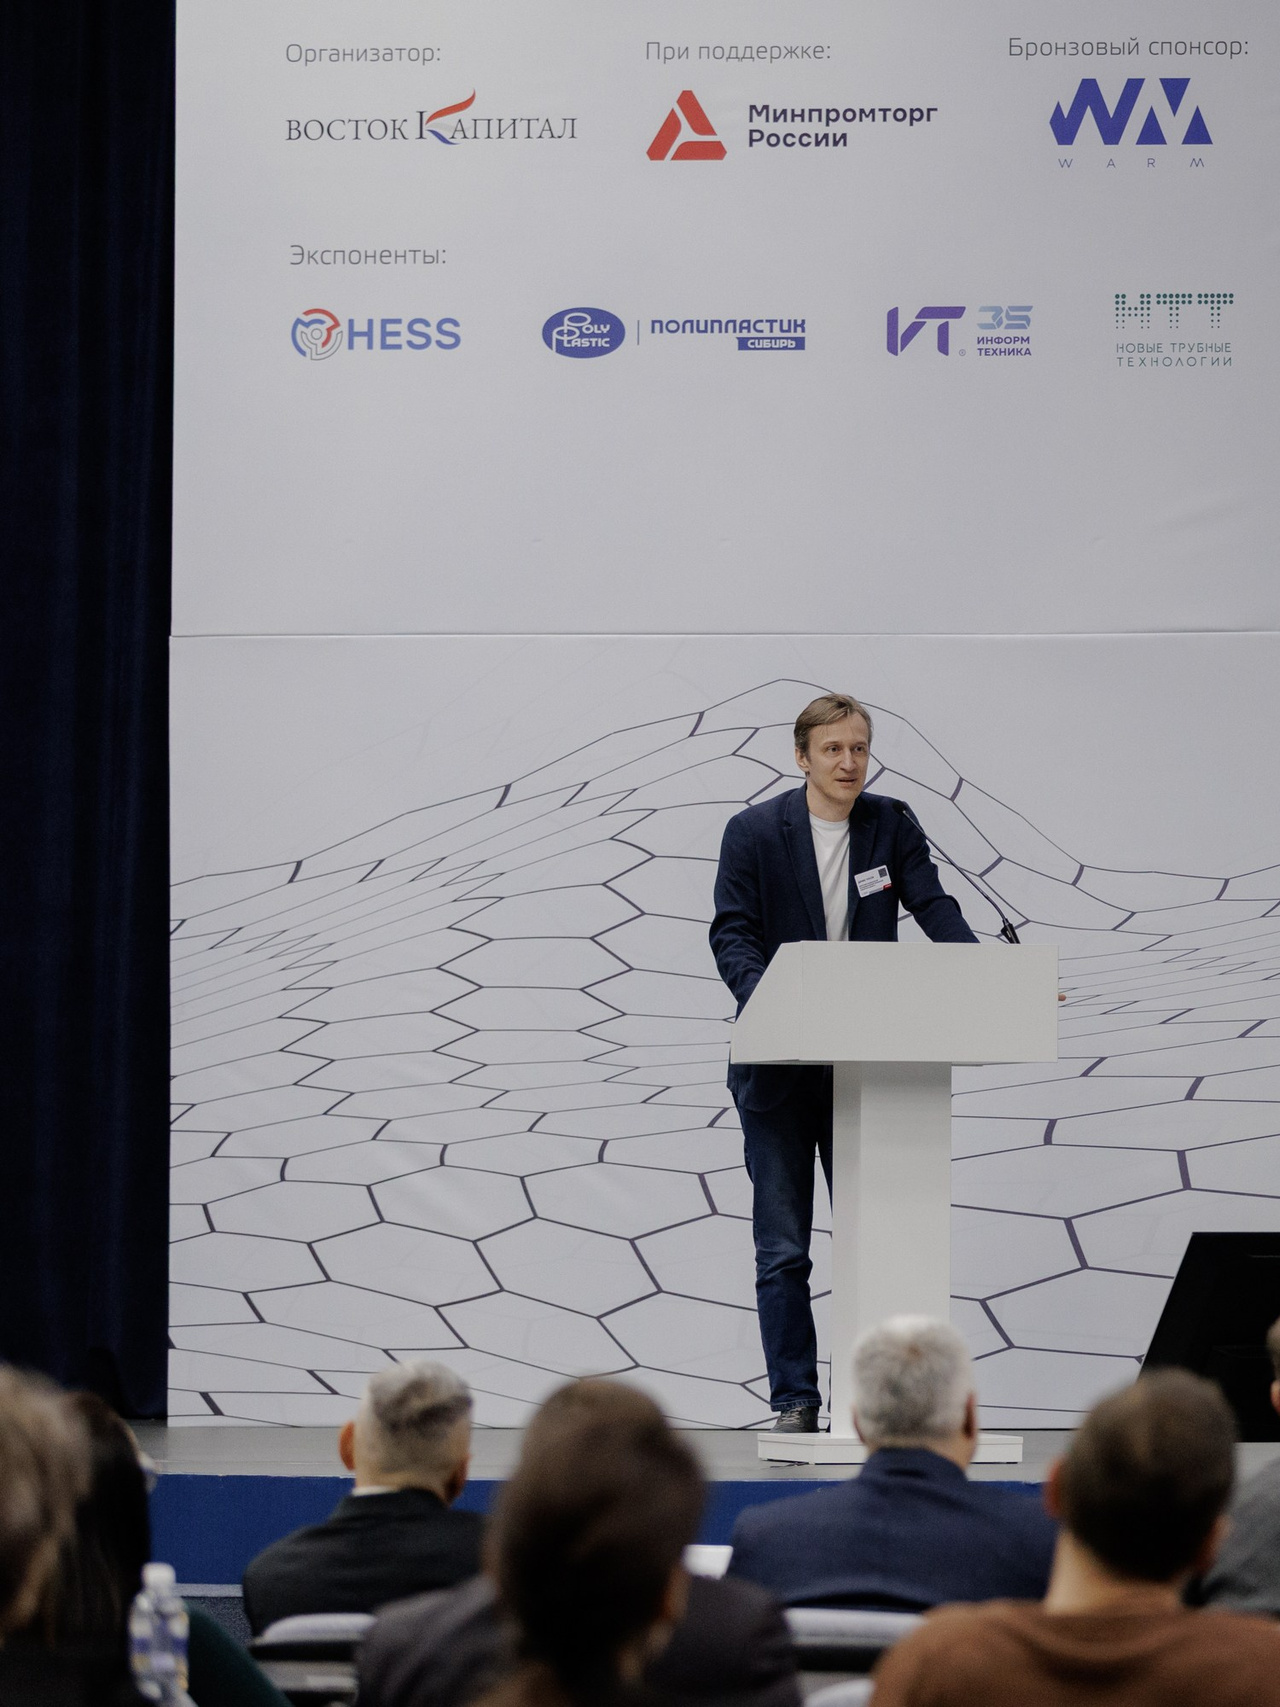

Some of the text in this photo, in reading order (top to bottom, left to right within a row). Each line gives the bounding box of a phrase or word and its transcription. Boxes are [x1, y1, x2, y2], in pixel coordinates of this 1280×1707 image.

[285, 43, 441, 67] Организатор:
[645, 41, 831, 64] При поддержке:
[1008, 37, 1249, 61] Бронзовый спонсор:
[748, 104, 939, 127] Минпромторг
[286, 118, 409, 141] ВОСТОК
[748, 128, 848, 148] России
[1058, 158, 1205, 169] WARM
[289, 244, 447, 267] Экспоненты:
[347, 316, 462, 351] HESS
[650, 319, 806, 334] ПОЛИПЛАСТИК
[747, 339, 796, 348] СИБИРЬ
[976, 335, 1031, 345] ИНФОРМ
[1116, 342, 1232, 354] НОВЫЕ ТРУБНЫЕ
[976, 347, 1032, 357] ТЕХНИКА
[1116, 356, 1233, 368] ТЕХНОЛОГИИ
